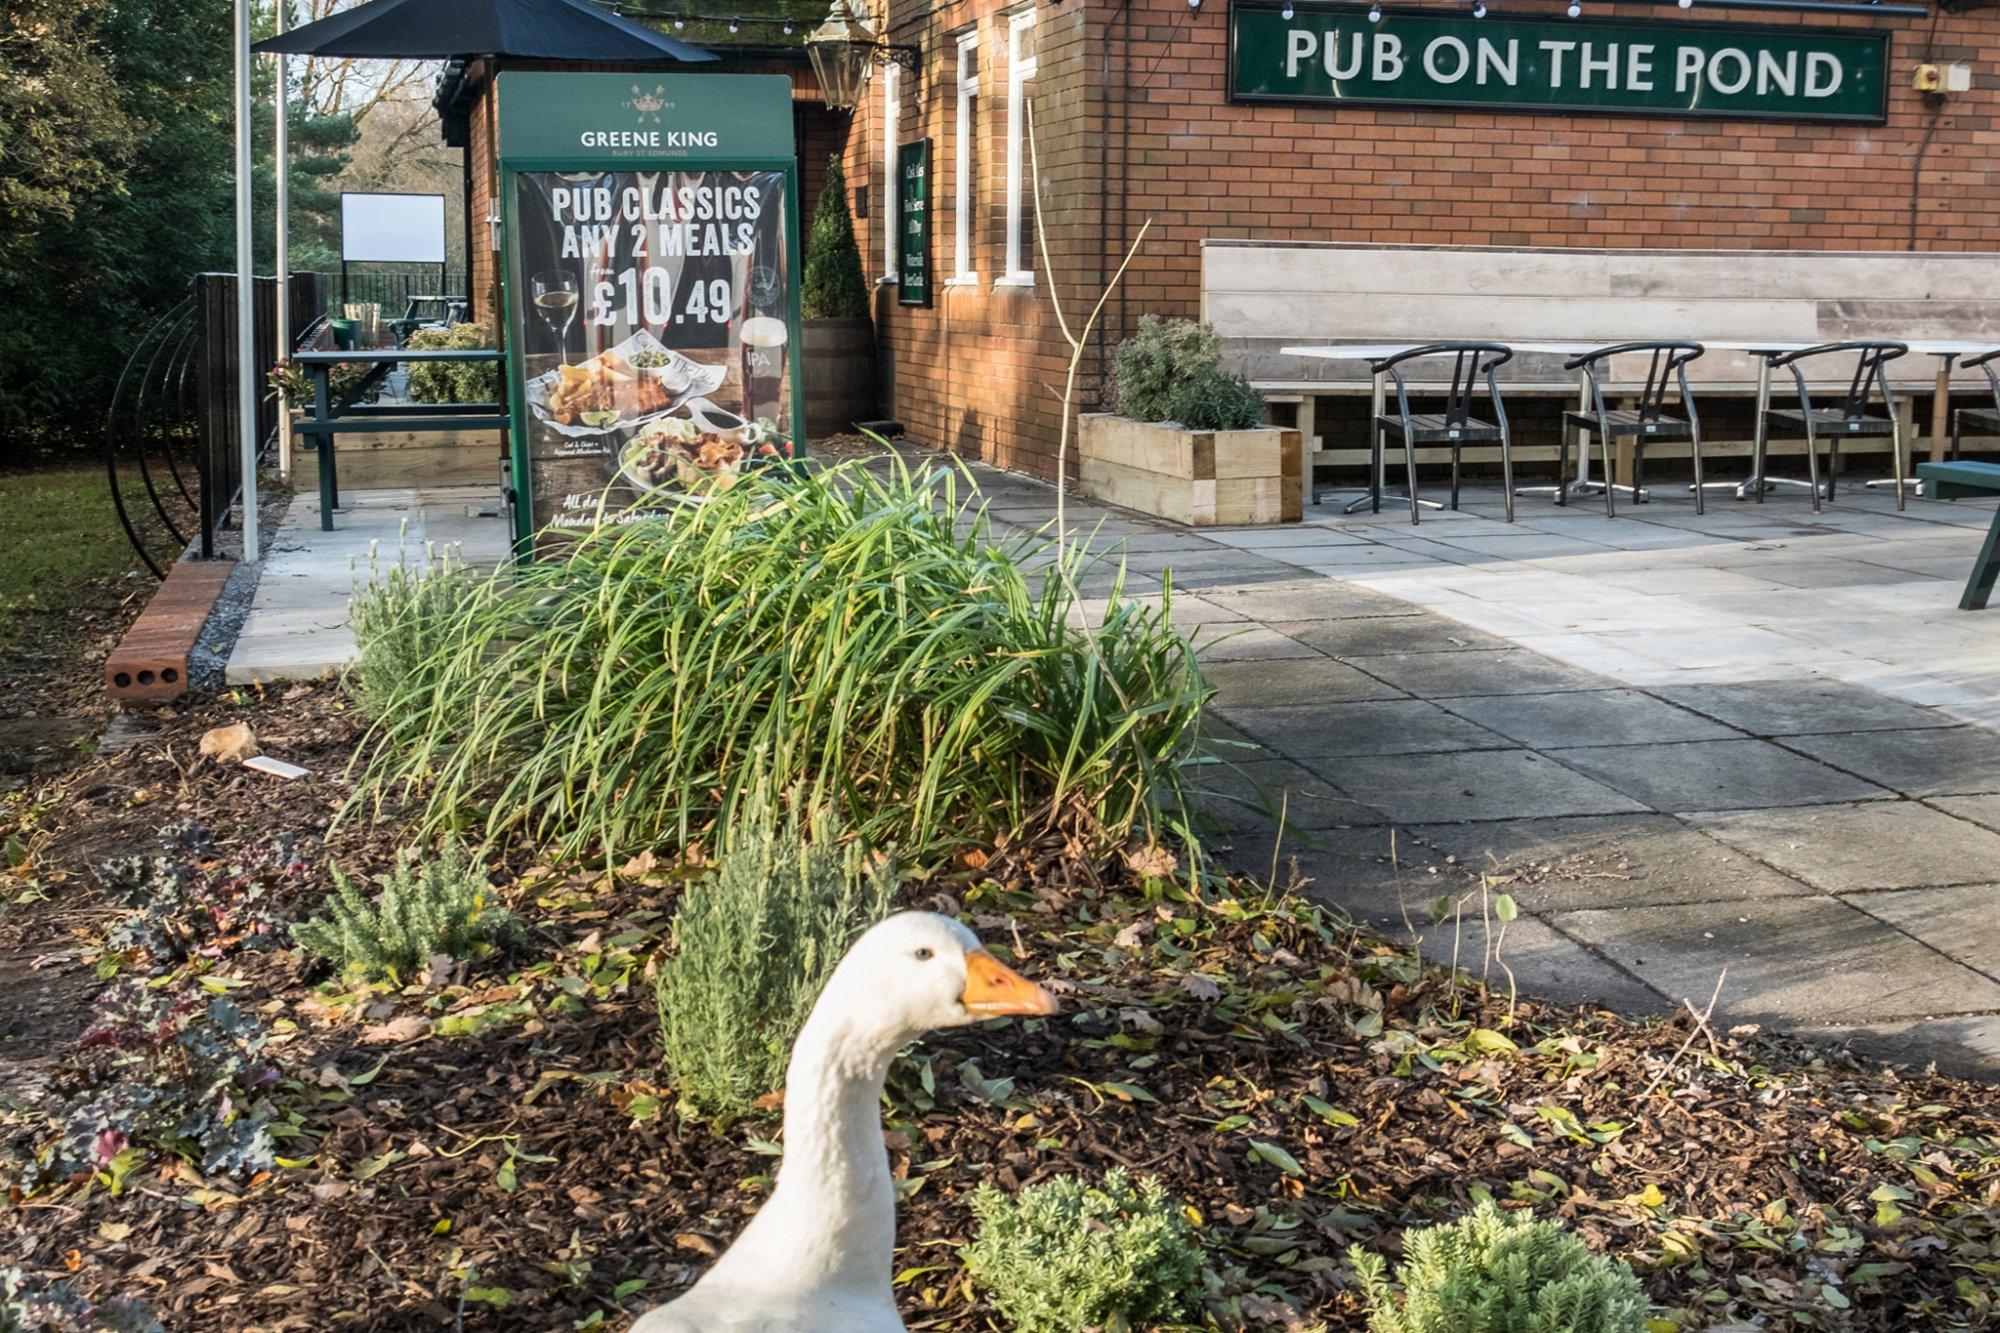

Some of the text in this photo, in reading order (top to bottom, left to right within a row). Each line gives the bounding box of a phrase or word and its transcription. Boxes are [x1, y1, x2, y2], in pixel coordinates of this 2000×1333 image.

[1286, 29, 1844, 98] PUB ON THE POND
[580, 131, 718, 147] GREENE KING
[552, 186, 762, 222] PUB CLASSICS
[562, 222, 756, 259] ANY 2 MEALS
[590, 262, 615, 276] from
[592, 265, 732, 327] £10.49
[746, 351, 771, 367] IPA
